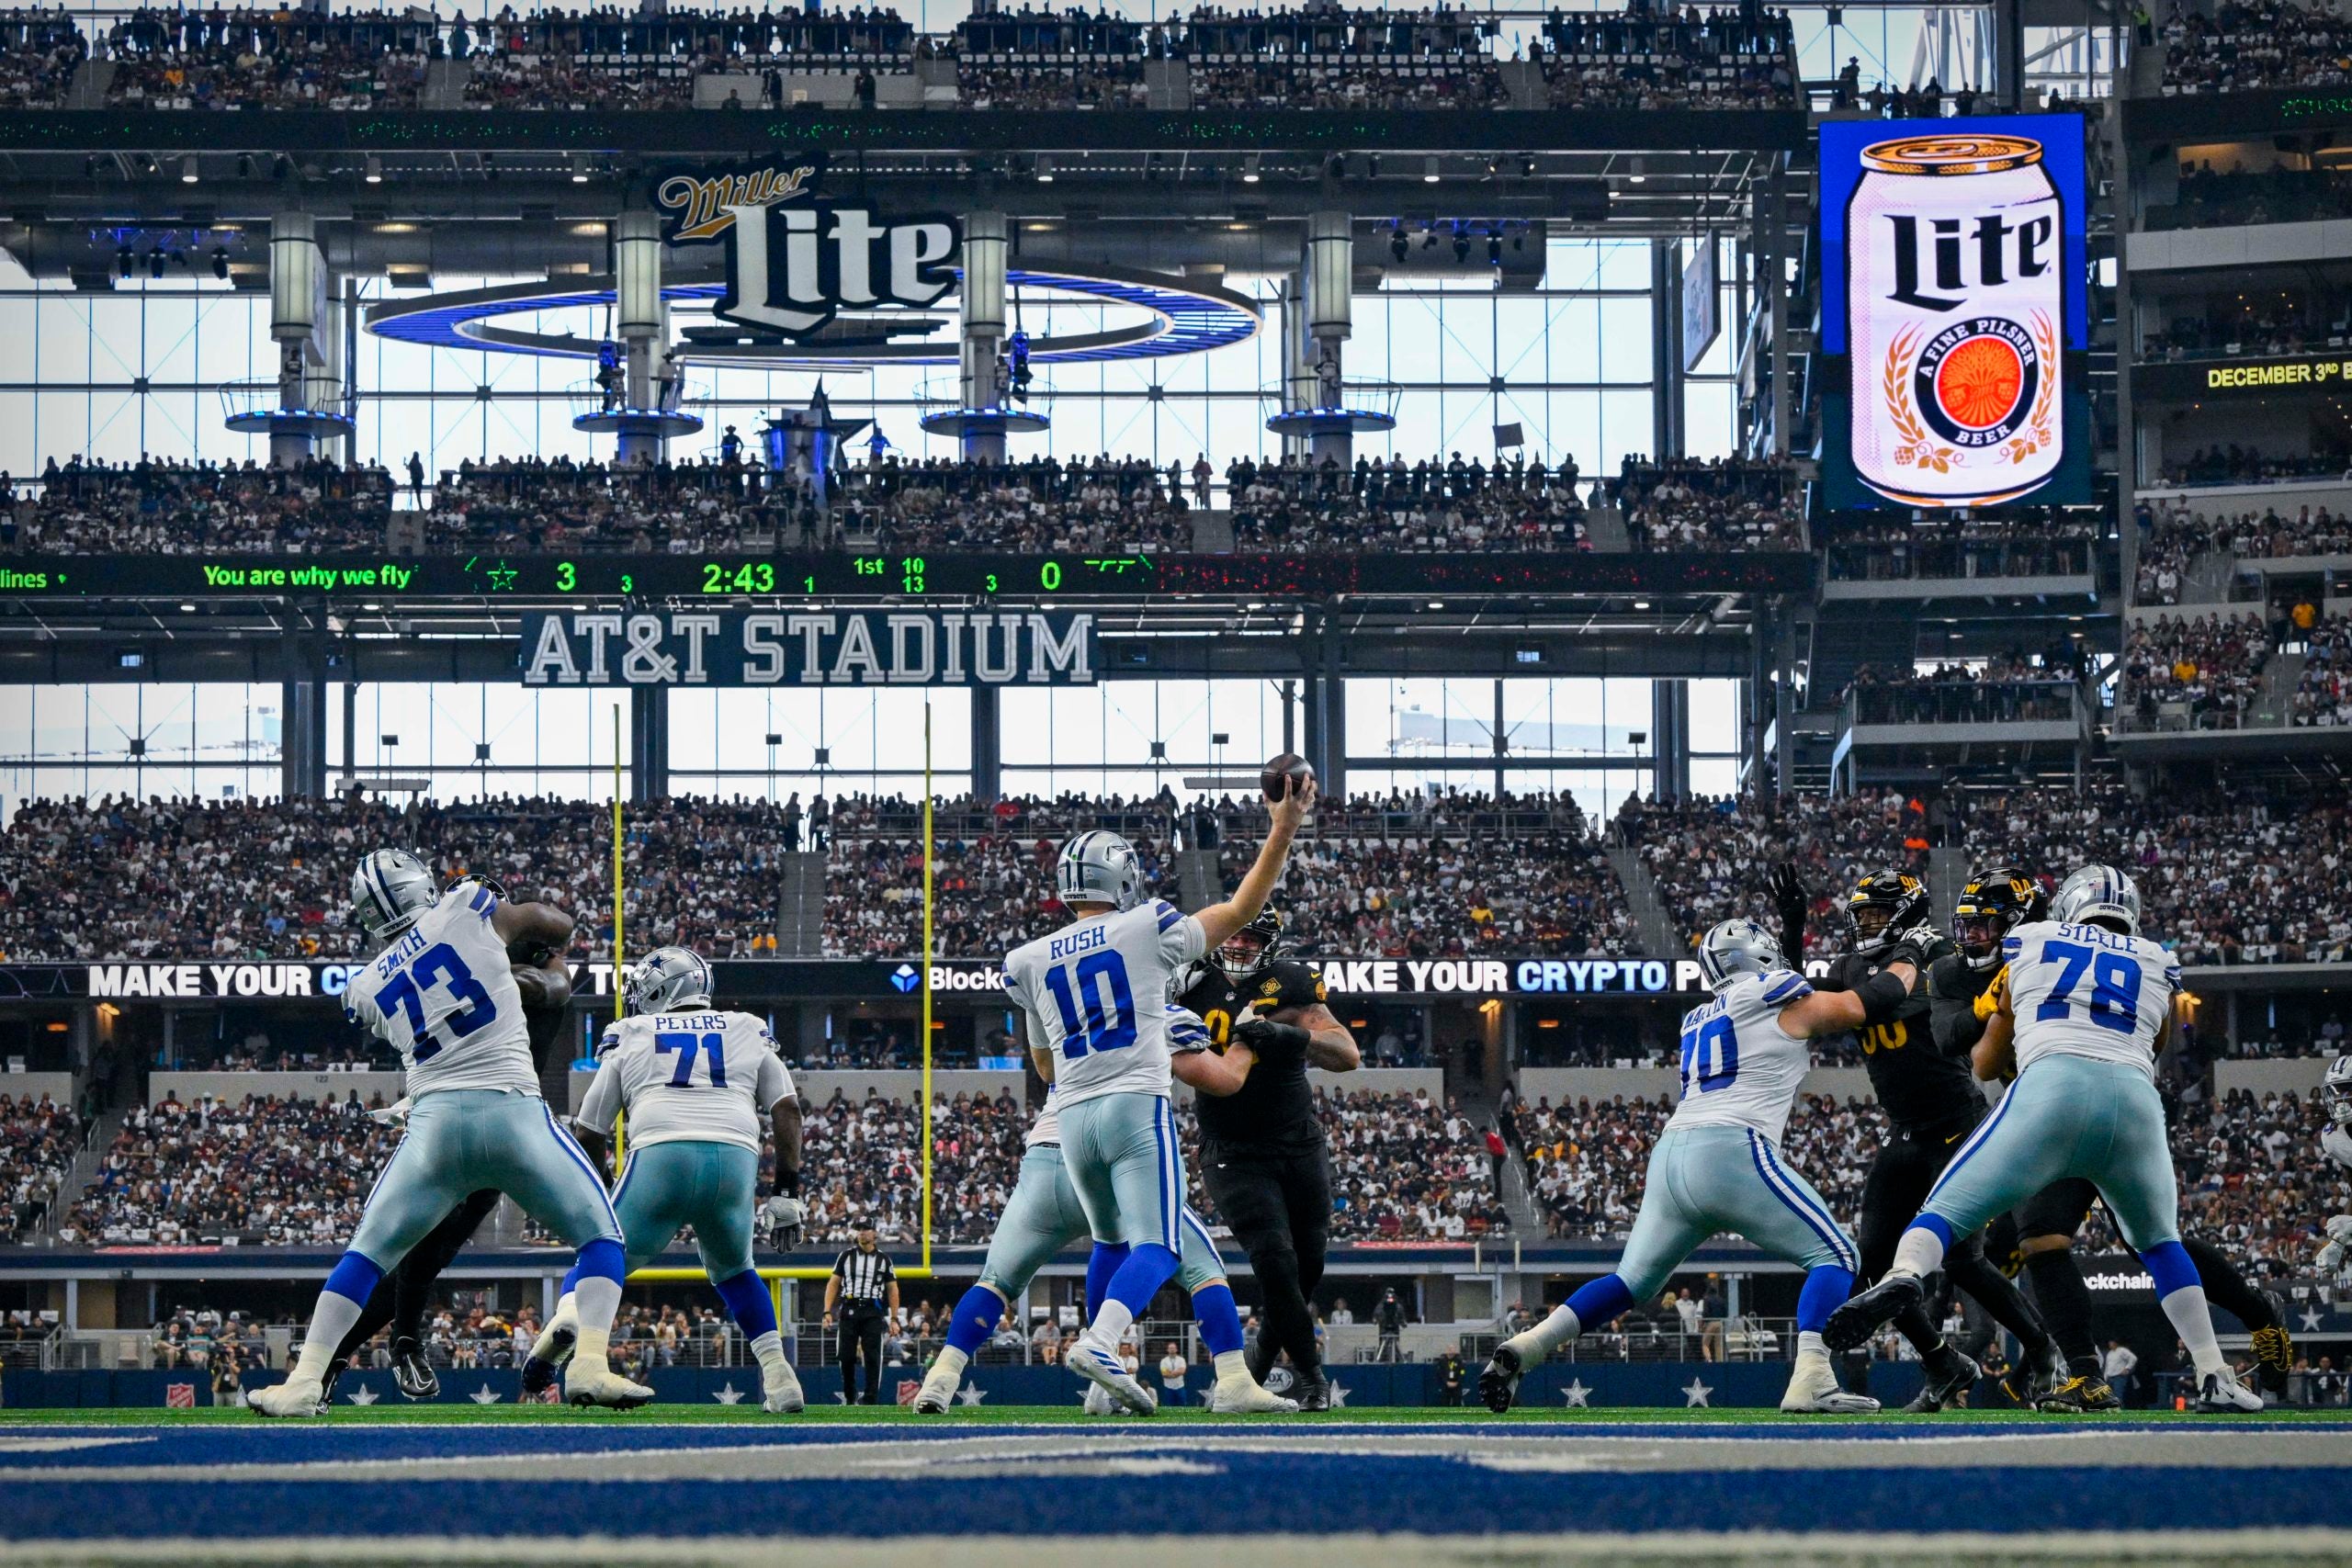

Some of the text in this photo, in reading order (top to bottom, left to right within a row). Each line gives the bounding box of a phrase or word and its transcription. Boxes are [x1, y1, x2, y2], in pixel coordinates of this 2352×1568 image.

[659, 165, 816, 241] Miller
[721, 205, 954, 332] Lite
[1882, 213, 2052, 312] Lite
[1918, 319, 2036, 378] A FINE PILSNER
[2208, 364, 2312, 388] DECEMBER
[1954, 423, 2011, 446] BEER
[203, 565, 412, 590] You are why we fly
[557, 562, 576, 592] 3
[703, 563, 775, 592] 2:43
[854, 557, 925, 575] 1st 10
[1041, 561, 1061, 591] 0
[621, 575, 633, 592] 3
[804, 576, 815, 593] 1
[901, 575, 925, 593] 13
[986, 574, 999, 592] 3
[525, 613, 1093, 683] AT&T STADIUM
[2098, 905, 2125, 914] COWBOYS
[378, 926, 427, 980] SMITH
[1050, 925, 1107, 961] RUSH
[2057, 922, 2139, 955] STEELE
[88, 965, 201, 997] MAKE
[209, 965, 312, 997] YOUR
[1308, 961, 1397, 993] AKE
[1406, 961, 1509, 993] YOUR
[1517, 961, 1667, 992] CRYPTO
[2036, 940, 2143, 1034] 78
[374, 942, 497, 1066] 73
[1044, 948, 1138, 1060] 10
[655, 1014, 728, 1031] PETERS
[654, 1032, 729, 1089] 71
[1679, 1014, 1740, 1101] 70
[2083, 1271, 2155, 1290] ckchain
